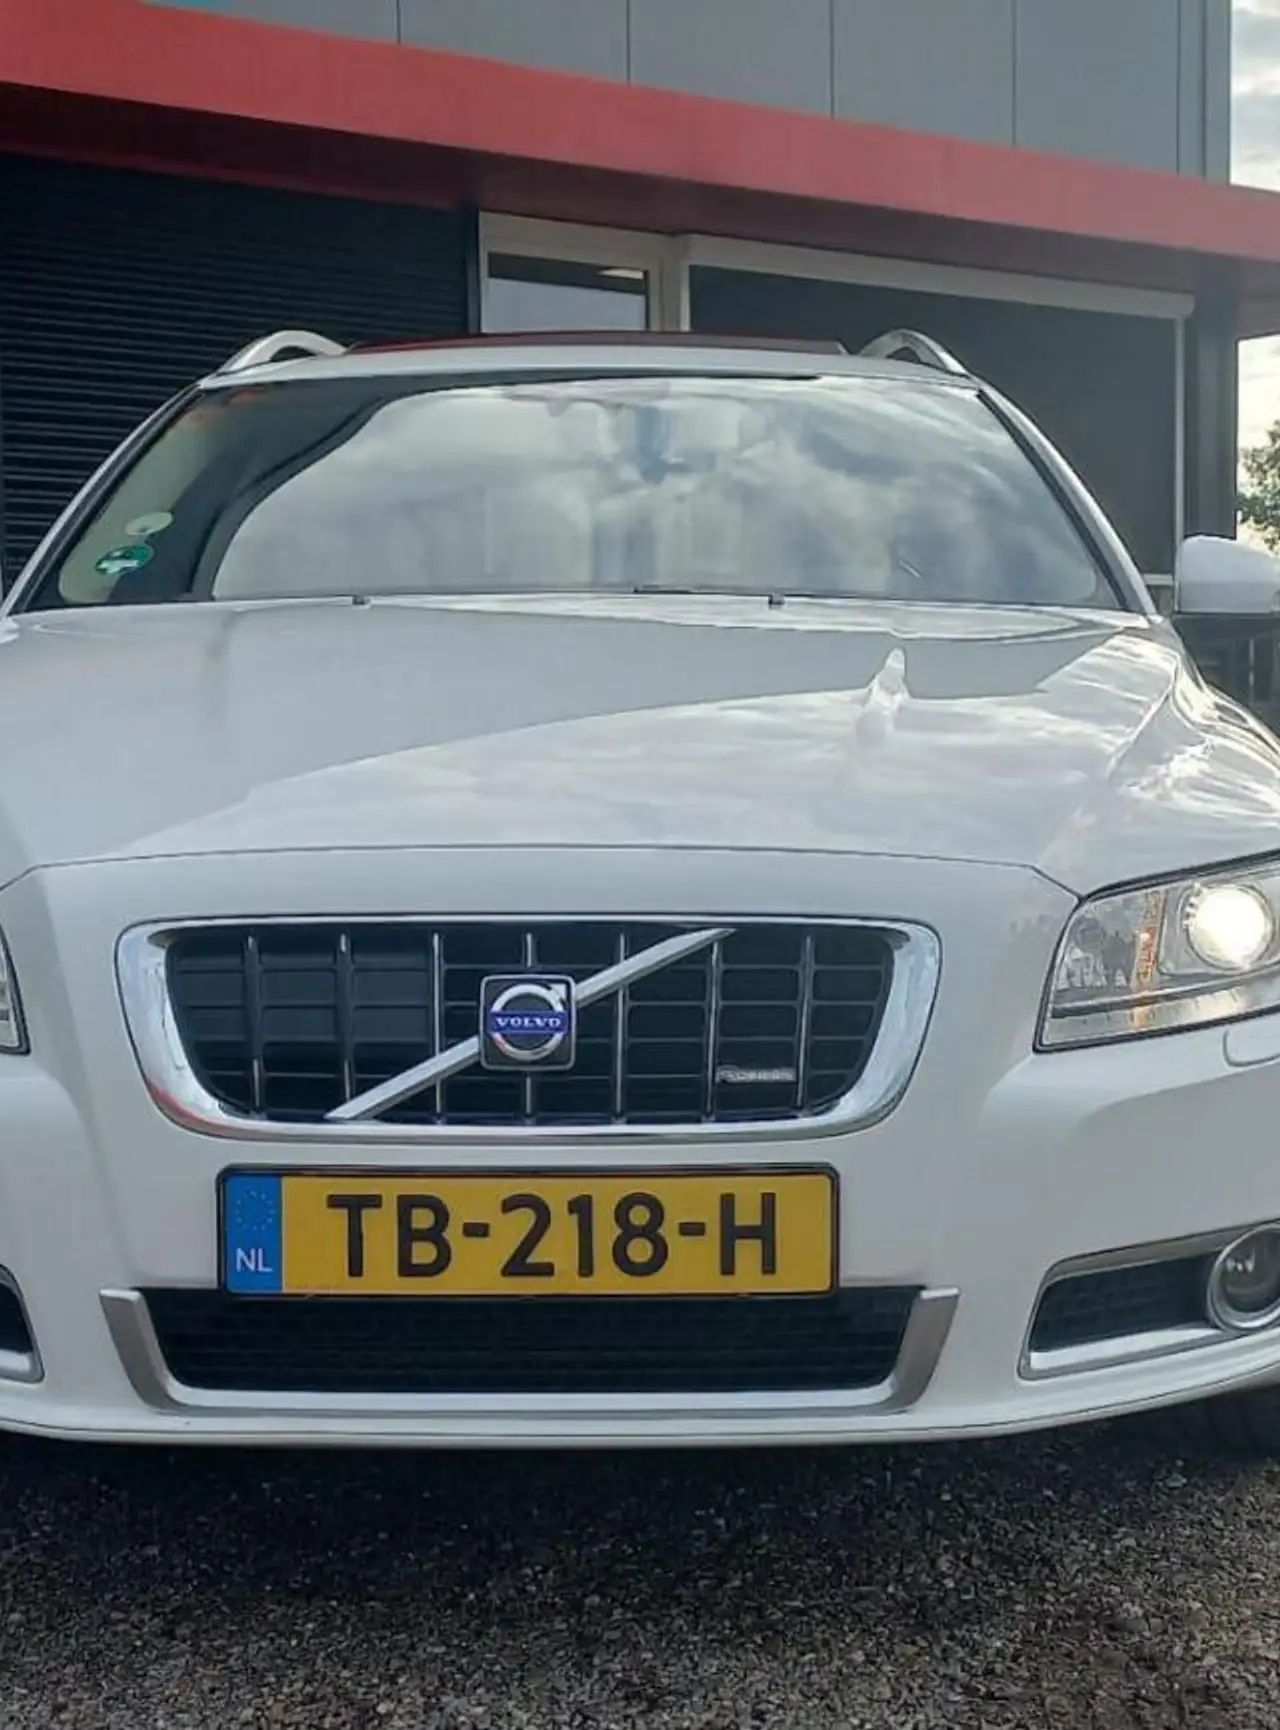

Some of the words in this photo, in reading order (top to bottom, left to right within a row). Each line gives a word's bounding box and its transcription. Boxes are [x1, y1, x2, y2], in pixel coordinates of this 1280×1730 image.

[495, 1016, 561, 1028] VOLVO
[235, 1247, 273, 1273] NL
[326, 1192, 777, 1278] TB-218-H
